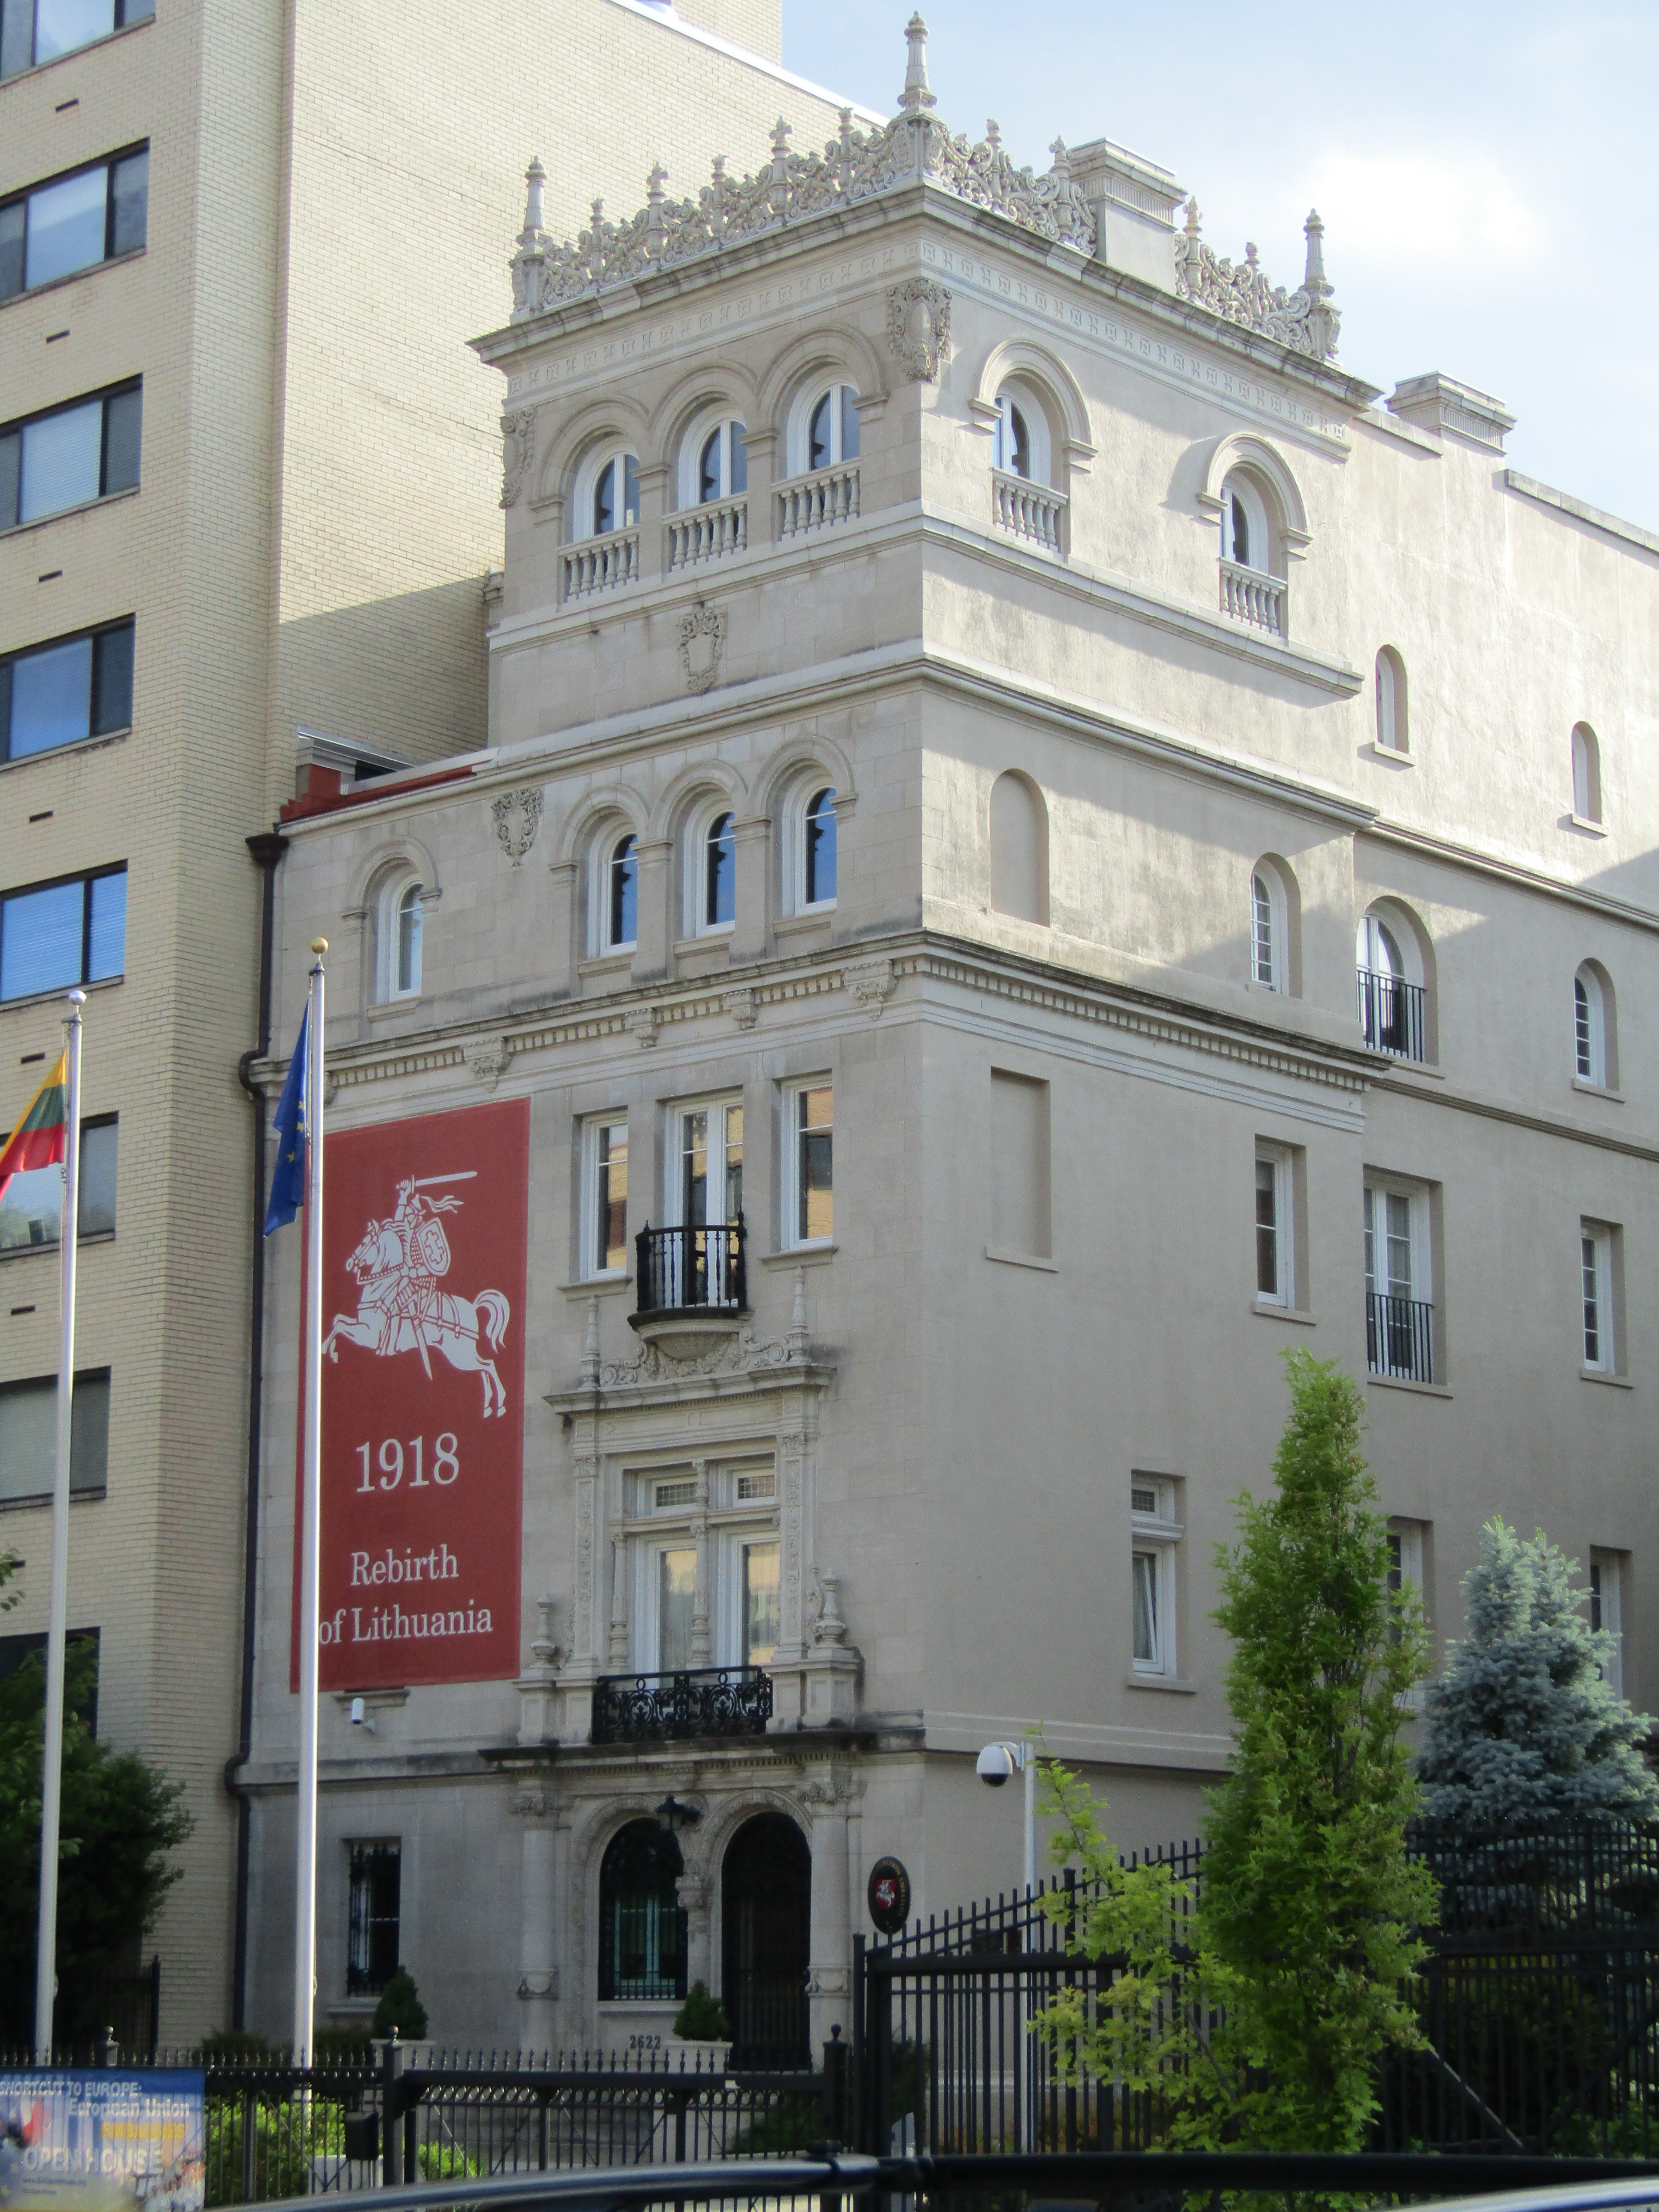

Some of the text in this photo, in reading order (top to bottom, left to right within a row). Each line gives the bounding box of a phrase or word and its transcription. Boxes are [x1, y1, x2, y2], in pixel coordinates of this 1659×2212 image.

[356, 1432, 459, 1492] 1918
[350, 1544, 459, 1586] Rebirth
[319, 1599, 493, 1644] of Lithuania
[630, 2035, 661, 2049] 2622
[0, 2081, 142, 2097] SHORTCUT TO EUROPE:
[70, 2098, 190, 2117] European Union
[24, 2147, 163, 2175] OPEN HOUSE
